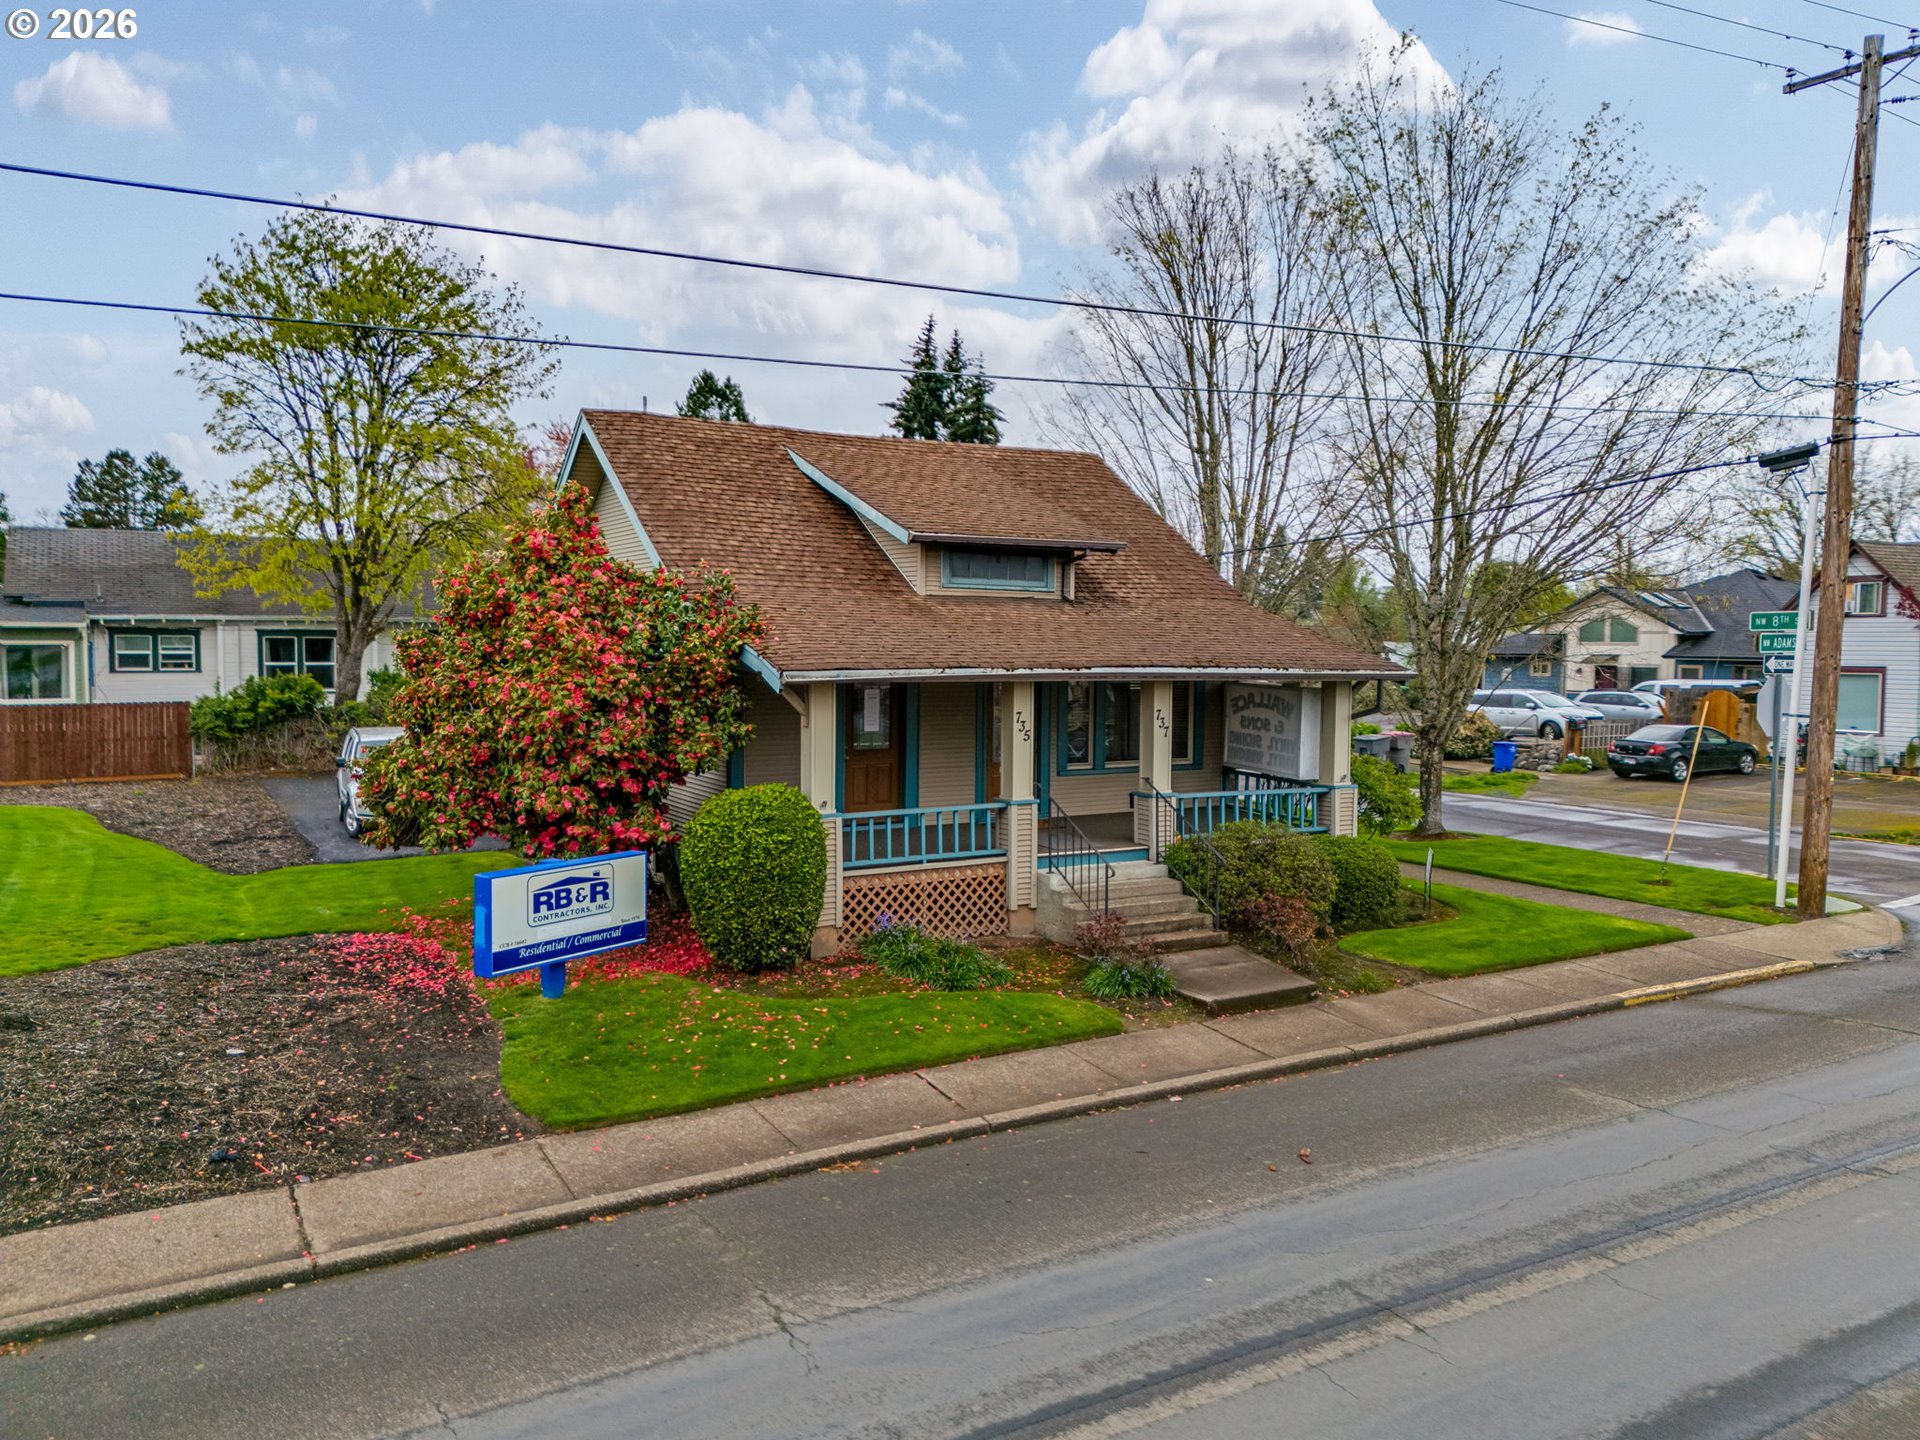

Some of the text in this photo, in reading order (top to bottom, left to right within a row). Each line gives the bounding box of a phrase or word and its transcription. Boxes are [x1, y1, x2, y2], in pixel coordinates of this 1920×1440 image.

[1772, 616, 1789, 626] 8TH
[1773, 638, 1796, 648] ADAMS
[1774, 660, 1784, 668] ONE
[1015, 711, 1031, 742] 735
[1155, 709, 1170, 738] 737
[532, 881, 610, 914] RB&R
[532, 903, 610, 923] CONTRACTORS, INC.
[518, 926, 623, 958] Residential / Commercial
